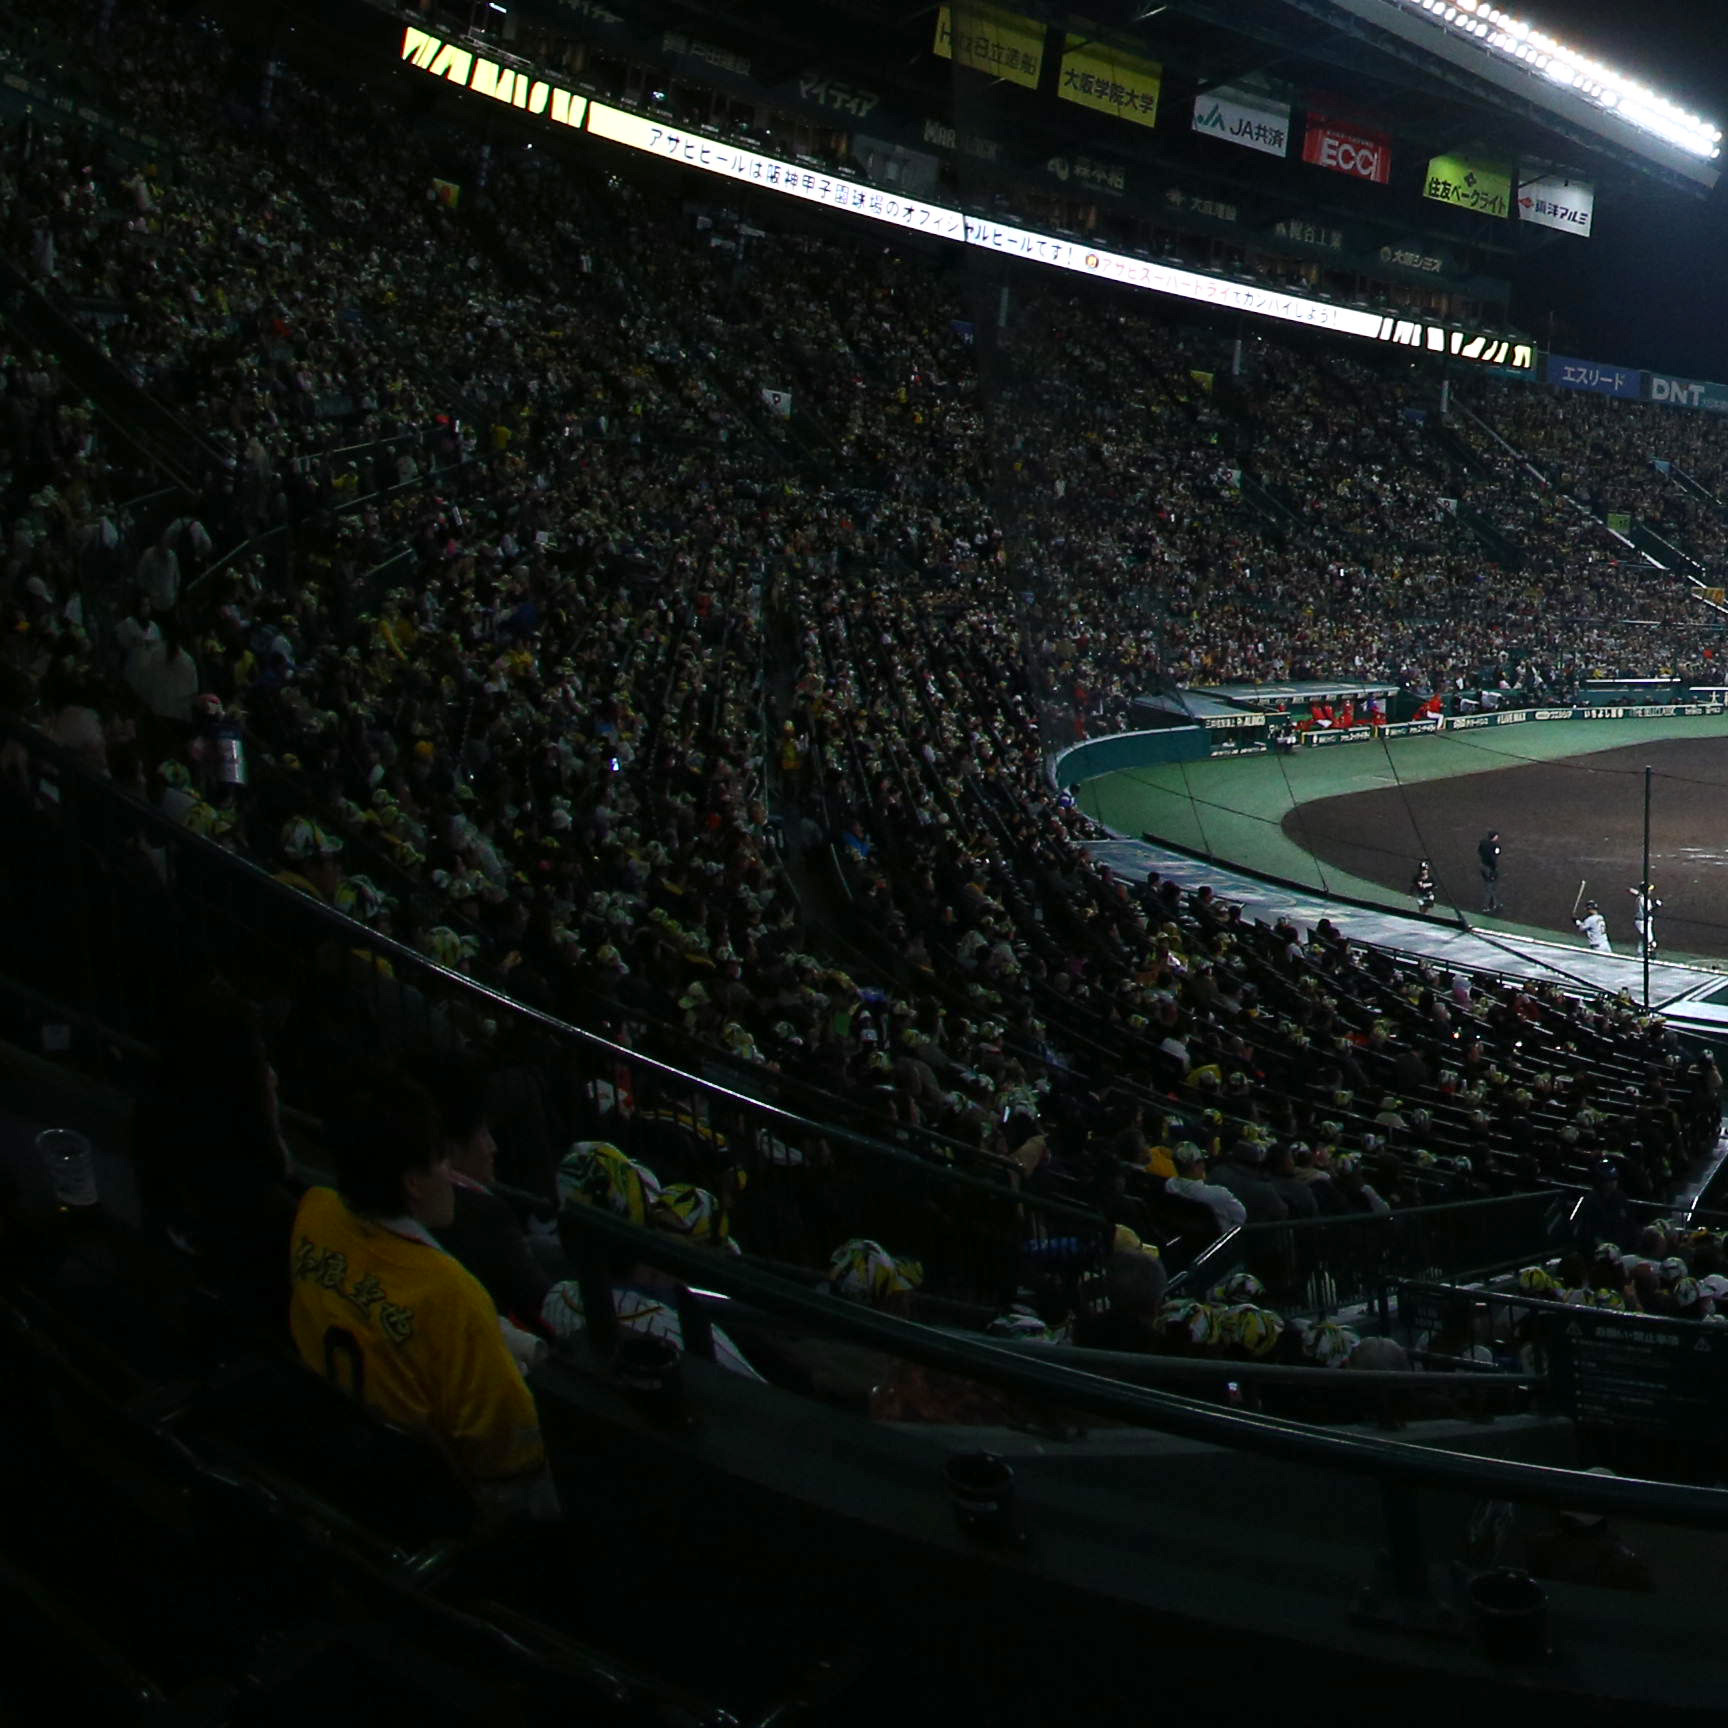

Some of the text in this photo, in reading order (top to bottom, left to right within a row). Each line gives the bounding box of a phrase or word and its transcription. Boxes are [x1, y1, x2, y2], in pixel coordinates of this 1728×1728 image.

[1062, 67, 1155, 115] 大阪学院大学
[1229, 117, 1285, 150] JA共済
[1427, 175, 1507, 215] 住友ベークライト
[1561, 365, 1625, 392] エスリード
[1651, 377, 1705, 407] DNT
